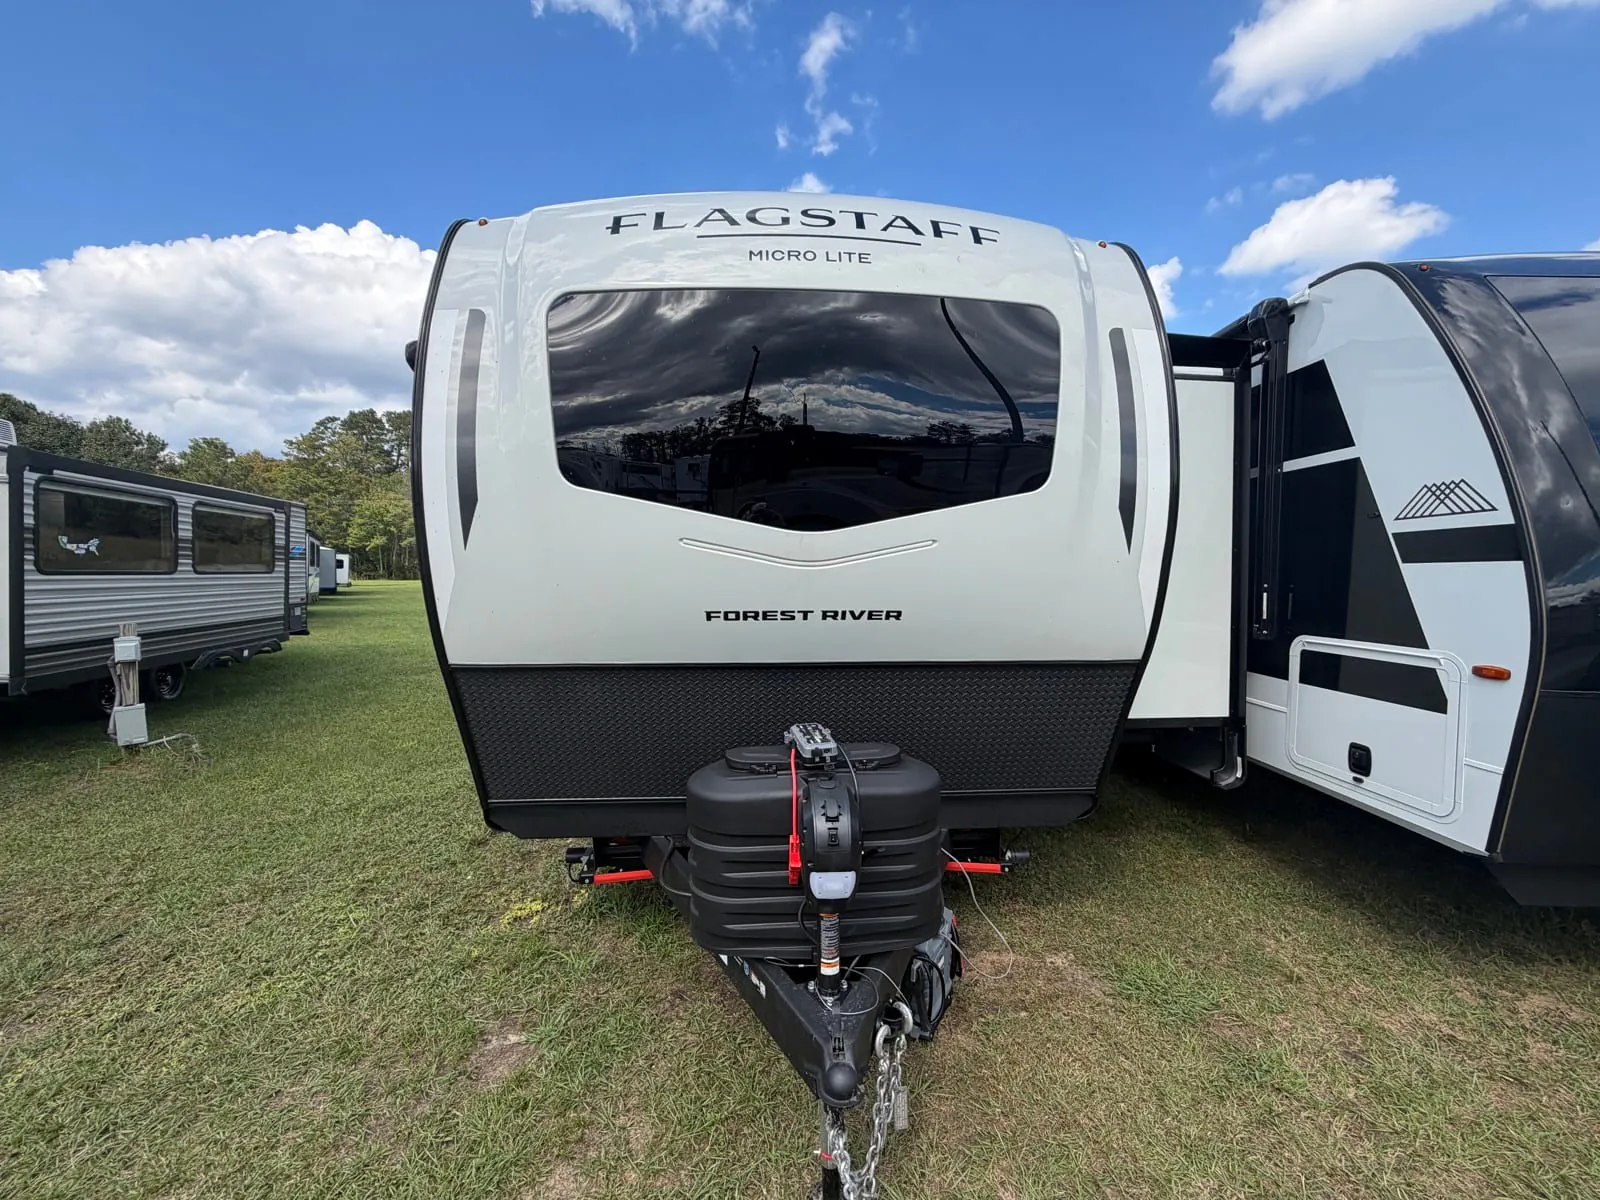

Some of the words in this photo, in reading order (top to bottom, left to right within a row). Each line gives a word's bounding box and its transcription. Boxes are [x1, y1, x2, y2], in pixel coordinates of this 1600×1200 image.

[606, 207, 1000, 246] FLAGSTAFF
[748, 249, 817, 262] MICRO
[825, 250, 872, 264] LITE
[704, 610, 814, 622] FOREST
[821, 610, 903, 621] RIVER
